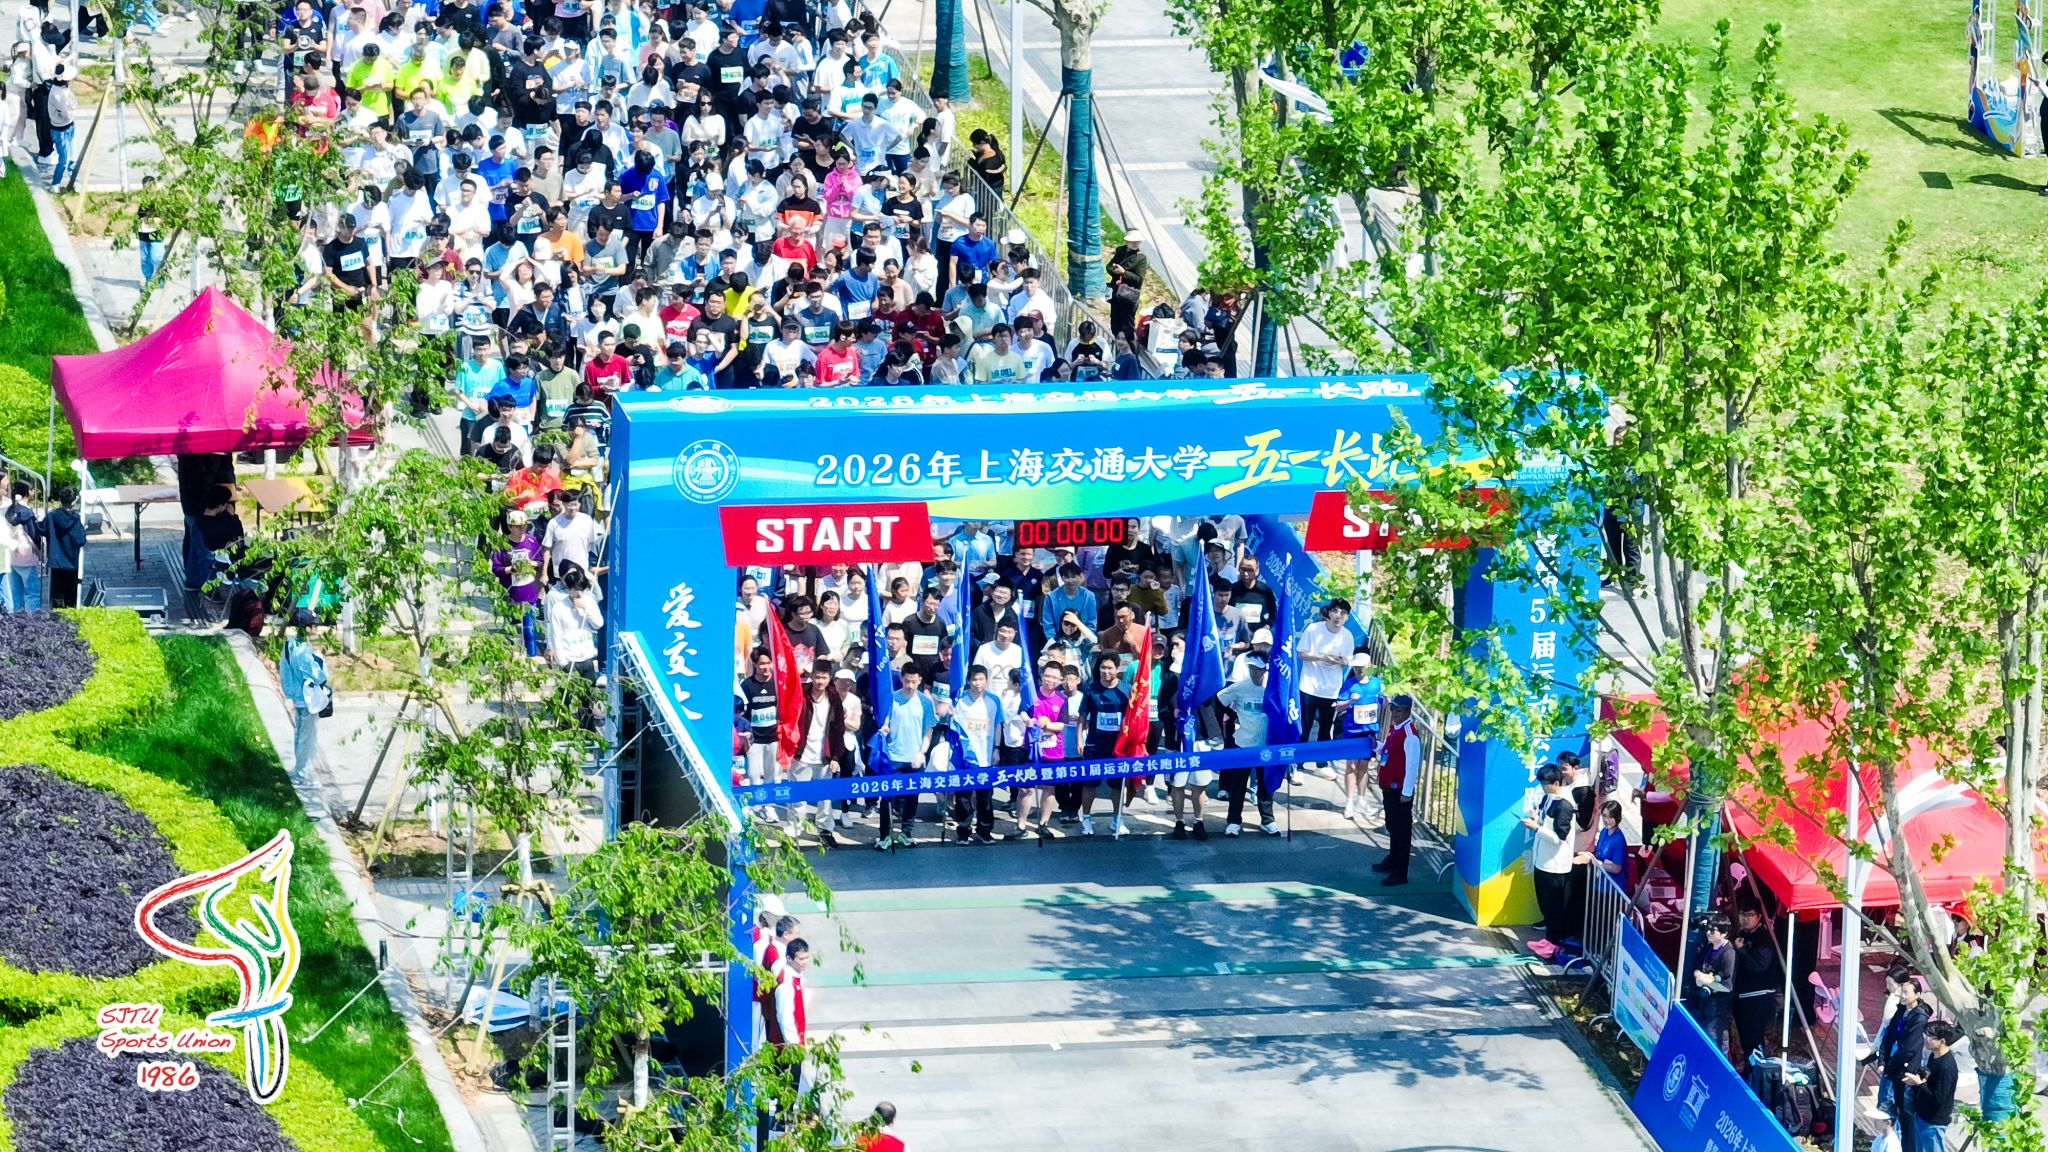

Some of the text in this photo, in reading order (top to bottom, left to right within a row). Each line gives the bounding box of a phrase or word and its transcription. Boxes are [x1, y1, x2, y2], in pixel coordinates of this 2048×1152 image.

[816, 442, 1210, 486] 2026年上海交通大学
[755, 515, 901, 553] START
